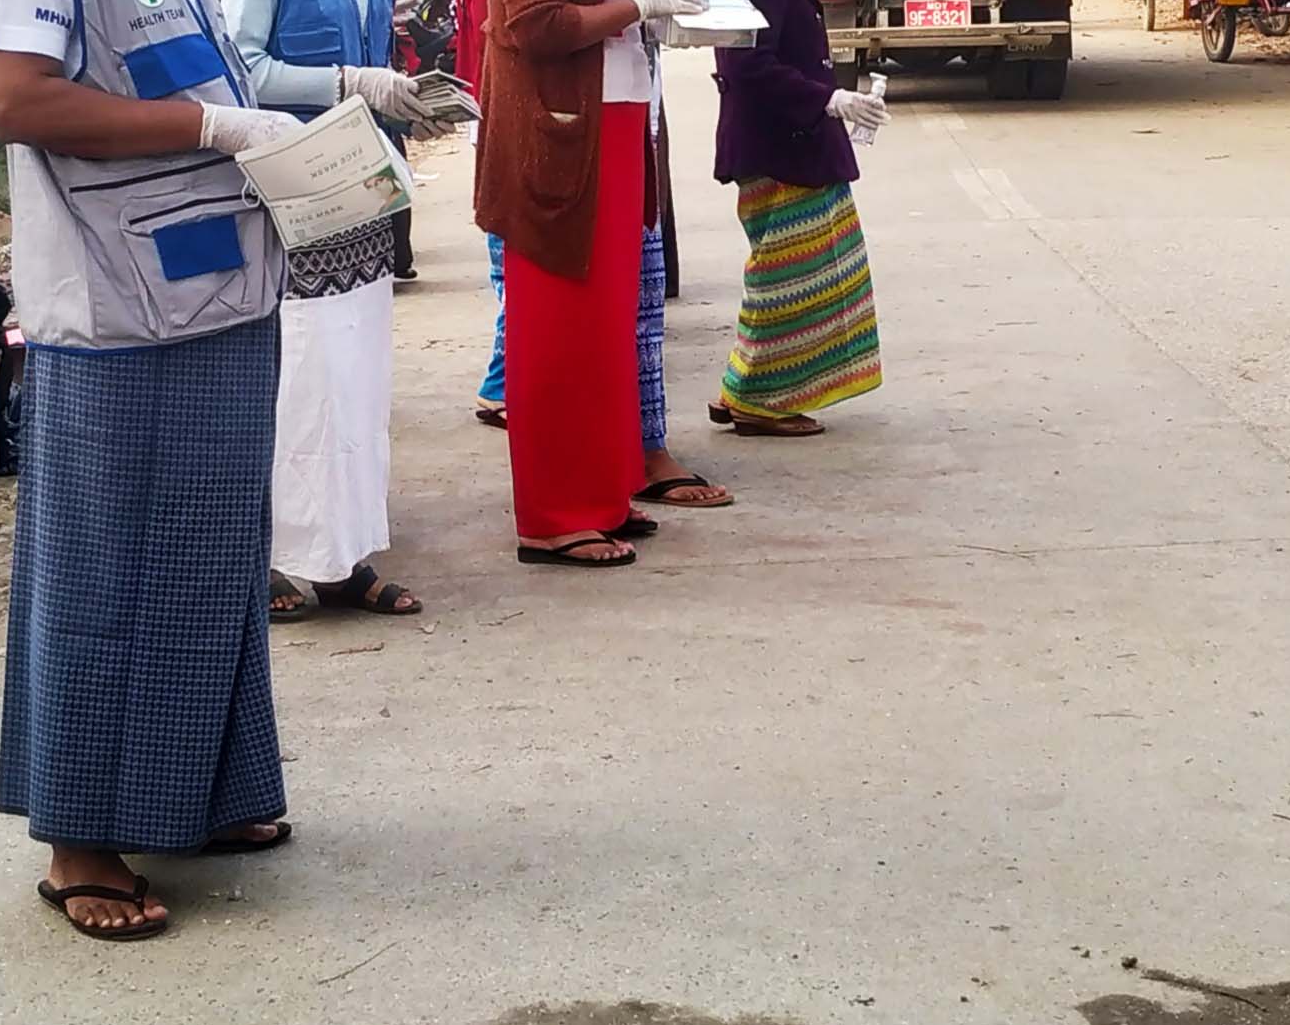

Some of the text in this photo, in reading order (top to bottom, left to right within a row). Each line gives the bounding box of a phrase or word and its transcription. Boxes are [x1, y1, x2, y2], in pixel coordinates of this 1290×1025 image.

[926, 2, 948, 11] MDY
[129, 7, 185, 31] HEALTH TEAM
[909, 10, 966, 26] 9F-8321
[289, 214, 313, 226] FACE
[316, 206, 344, 218] MASK
